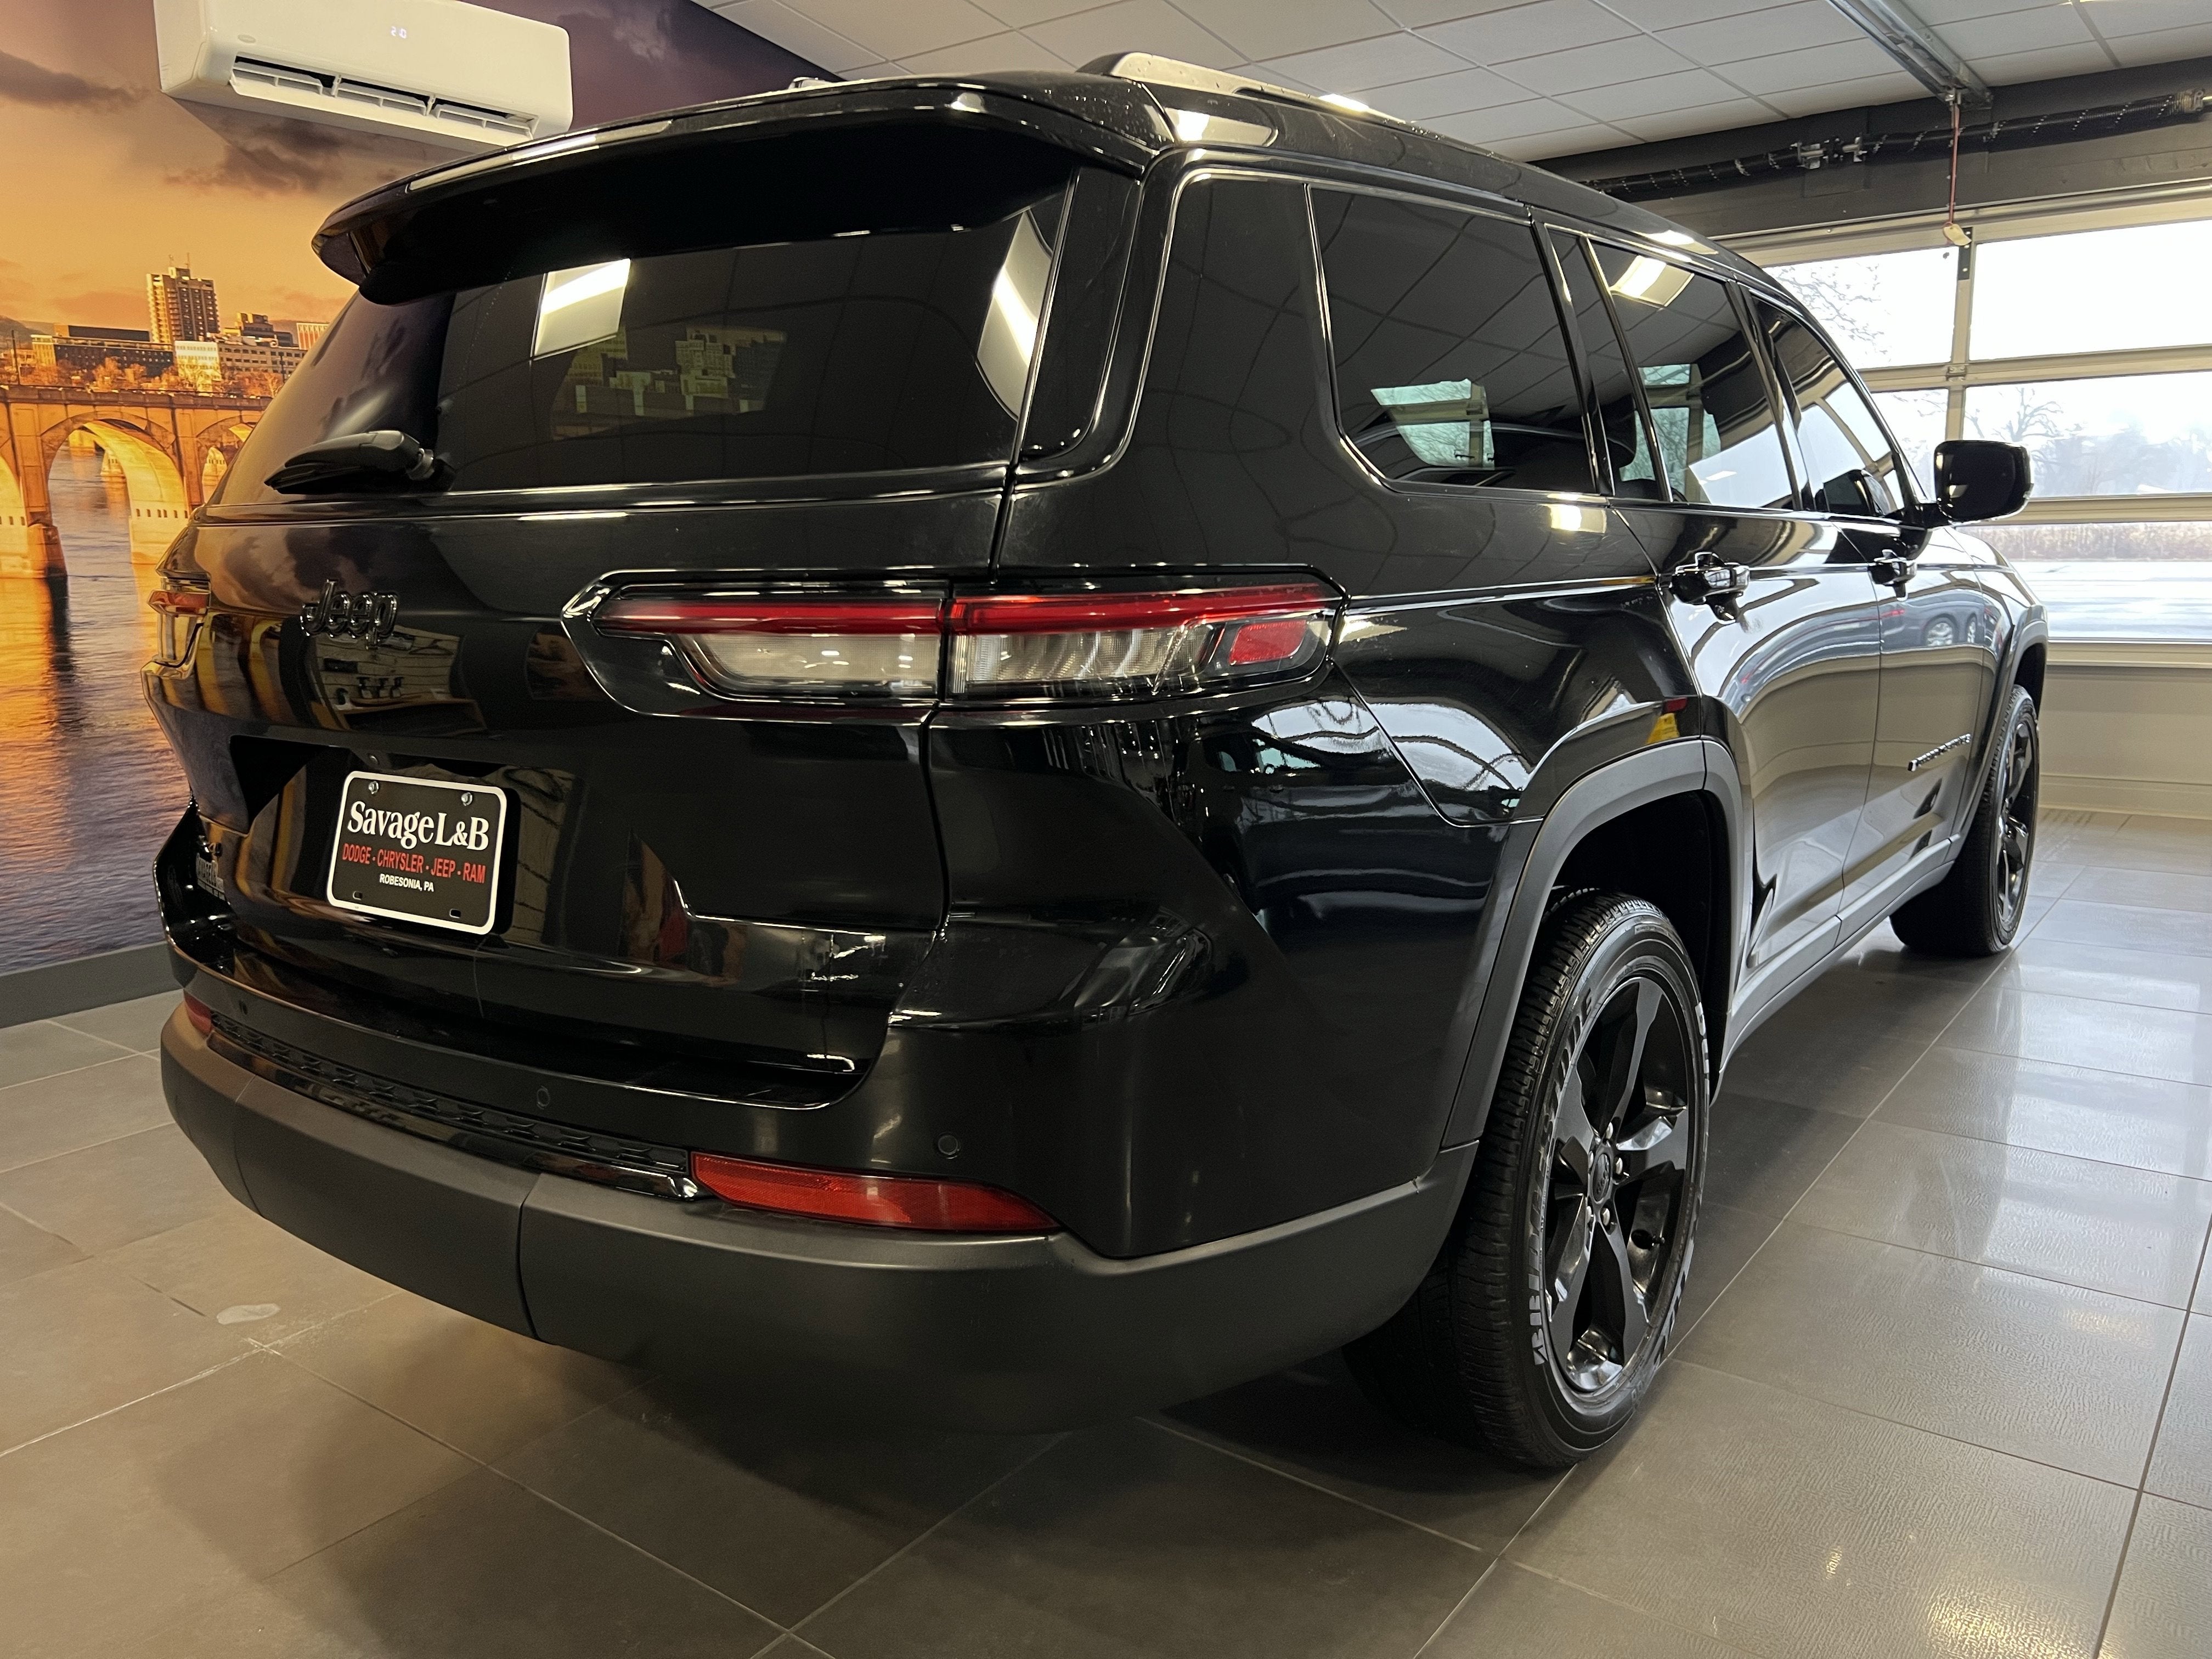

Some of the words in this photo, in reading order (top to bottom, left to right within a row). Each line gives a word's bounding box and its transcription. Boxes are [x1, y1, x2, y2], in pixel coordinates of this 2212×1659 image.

[300, 579, 398, 650] Jeep
[342, 843, 372, 865] DODGE
[377, 849, 424, 873] CHRYSLER
[430, 857, 456, 878] JEEP
[463, 863, 486, 884] RAM
[379, 873, 422, 891] ROBESONIA,
[424, 881, 435, 892] PA
